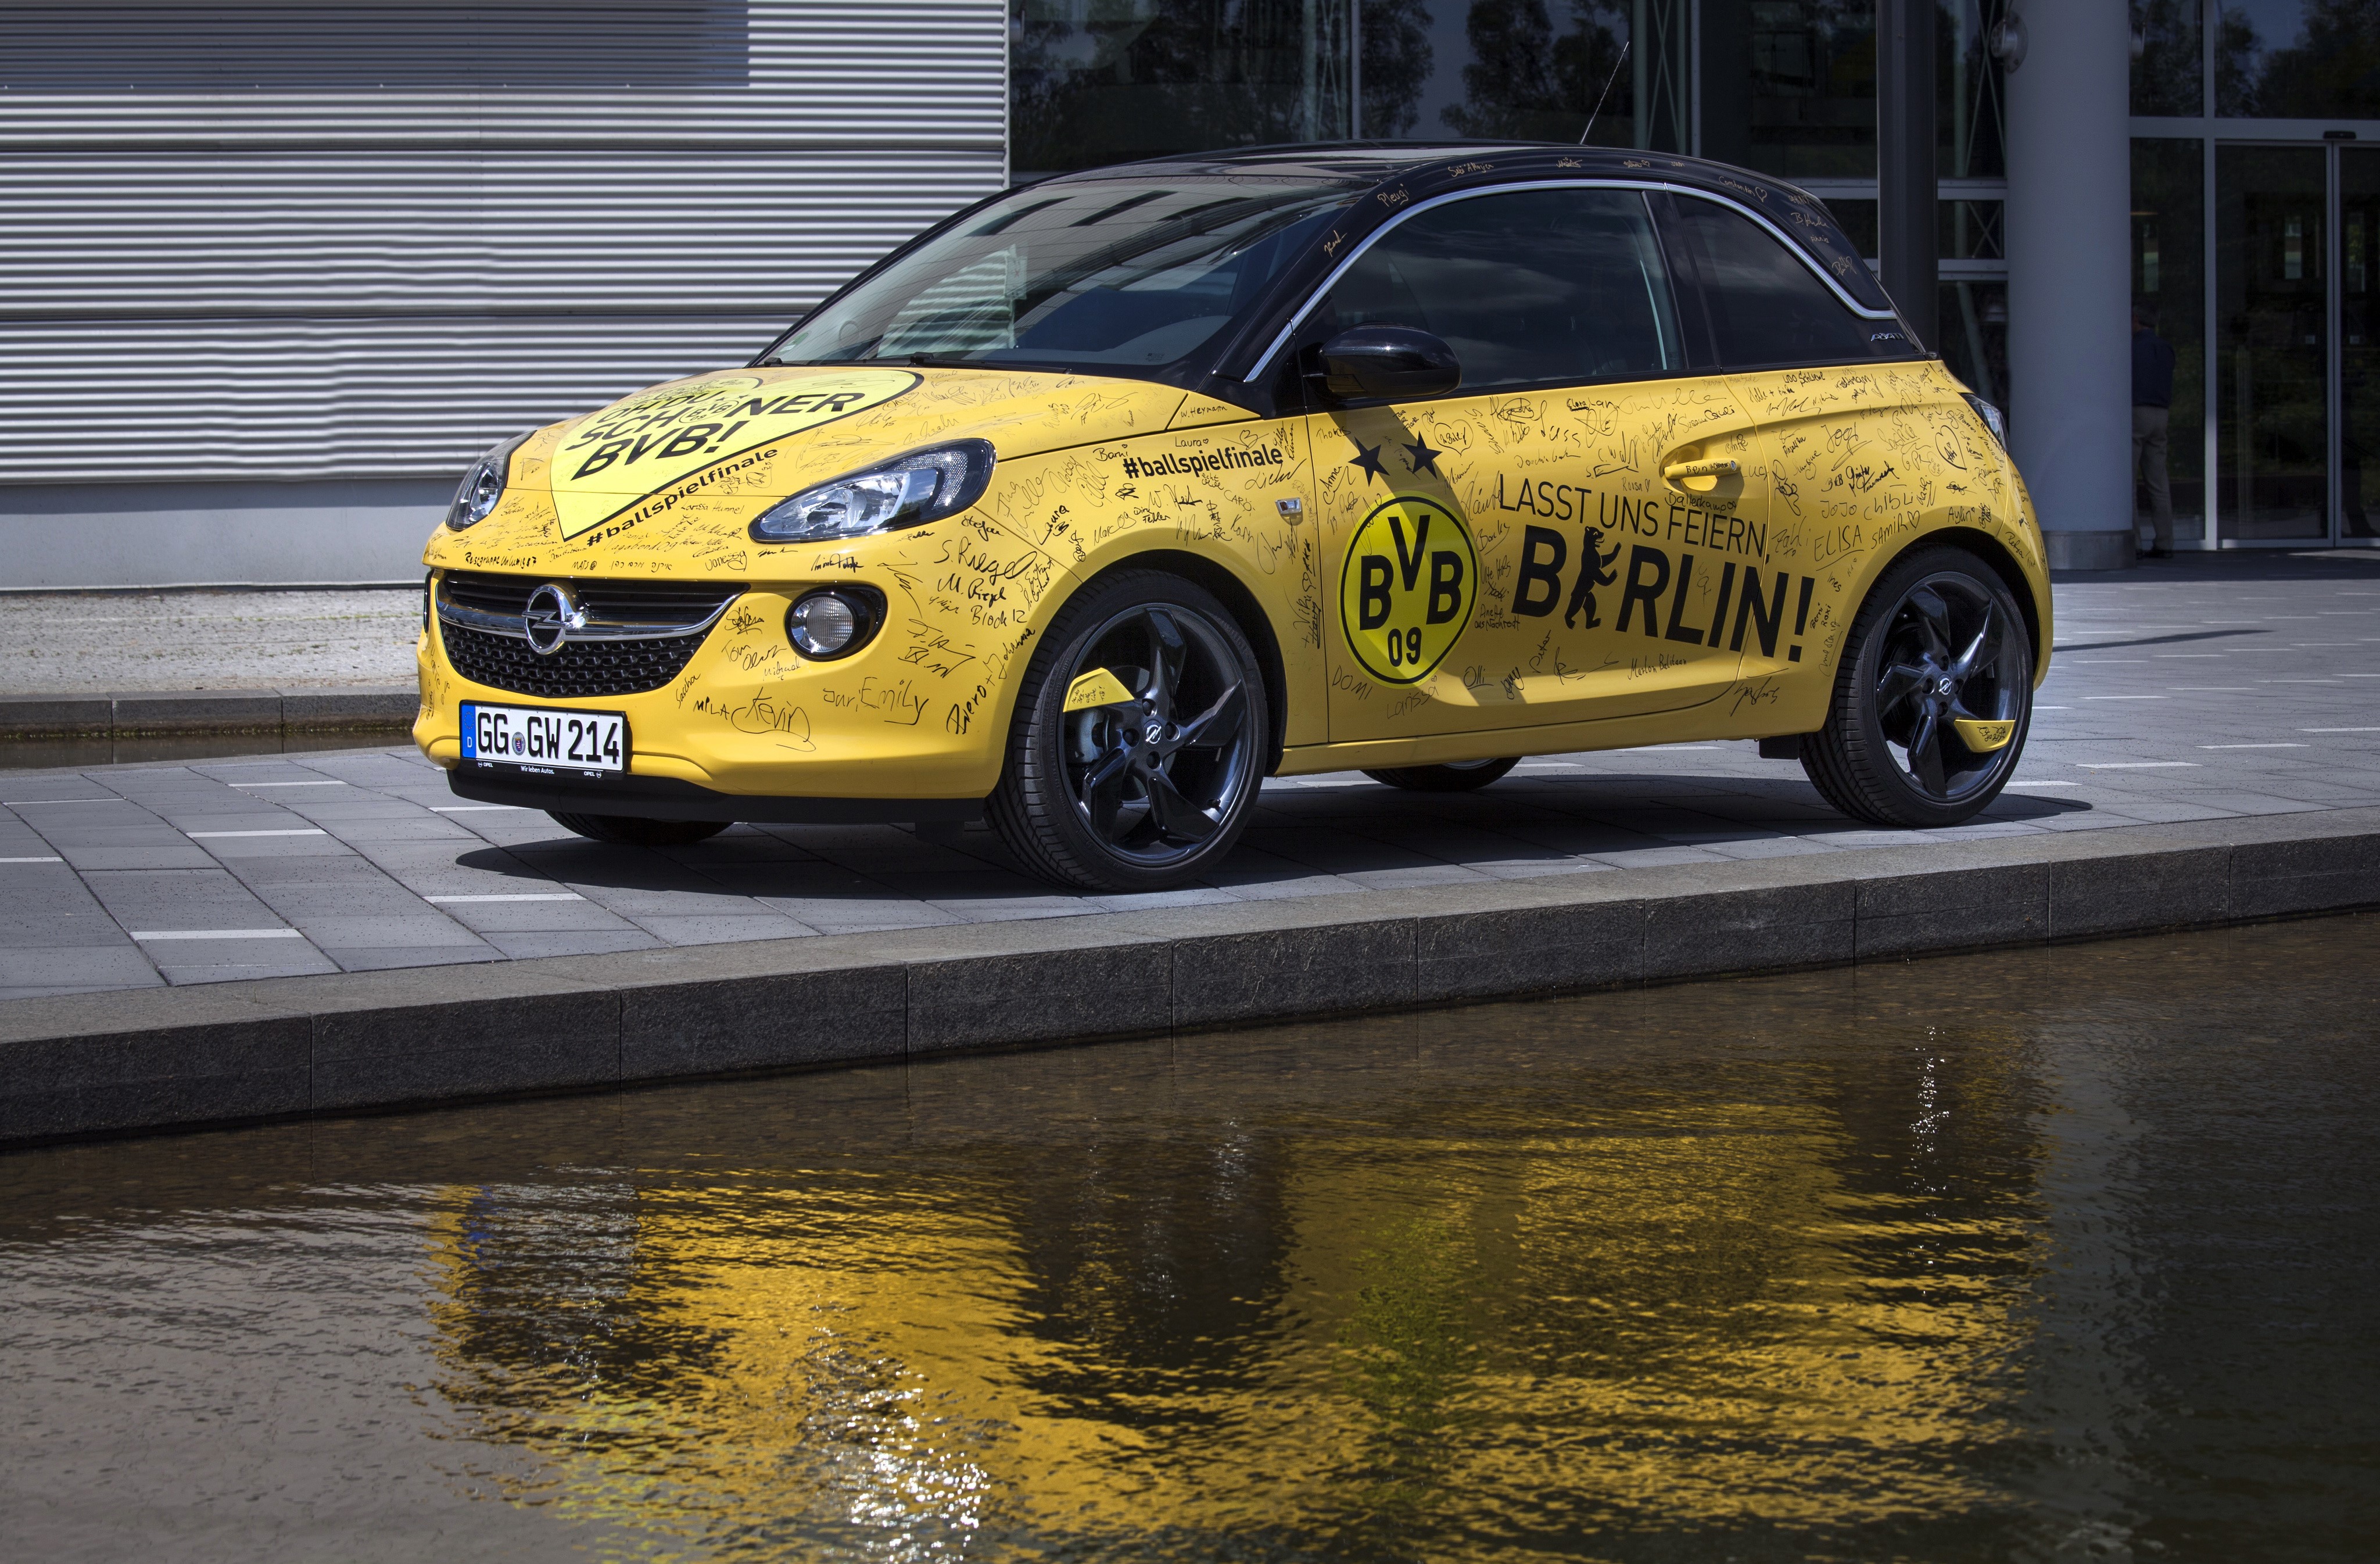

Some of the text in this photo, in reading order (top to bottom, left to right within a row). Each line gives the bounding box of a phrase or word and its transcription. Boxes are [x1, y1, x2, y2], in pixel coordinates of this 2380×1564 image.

[570, 420, 751, 481] BVB!
[1122, 443, 1284, 479] #ballspielfinale
[1174, 436, 1203, 448] Laura
[586, 449, 778, 547] #ballspielfinale
[1499, 474, 1592, 524] LASST
[1600, 492, 1659, 538] UNS
[1666, 506, 1770, 565] FEIERN,
[1813, 524, 1863, 563] ELISA
[1359, 514, 1465, 631] BVB
[1387, 626, 1422, 668] 09
[467, 736, 473, 748] D
[478, 712, 620, 765] GG GW 214
